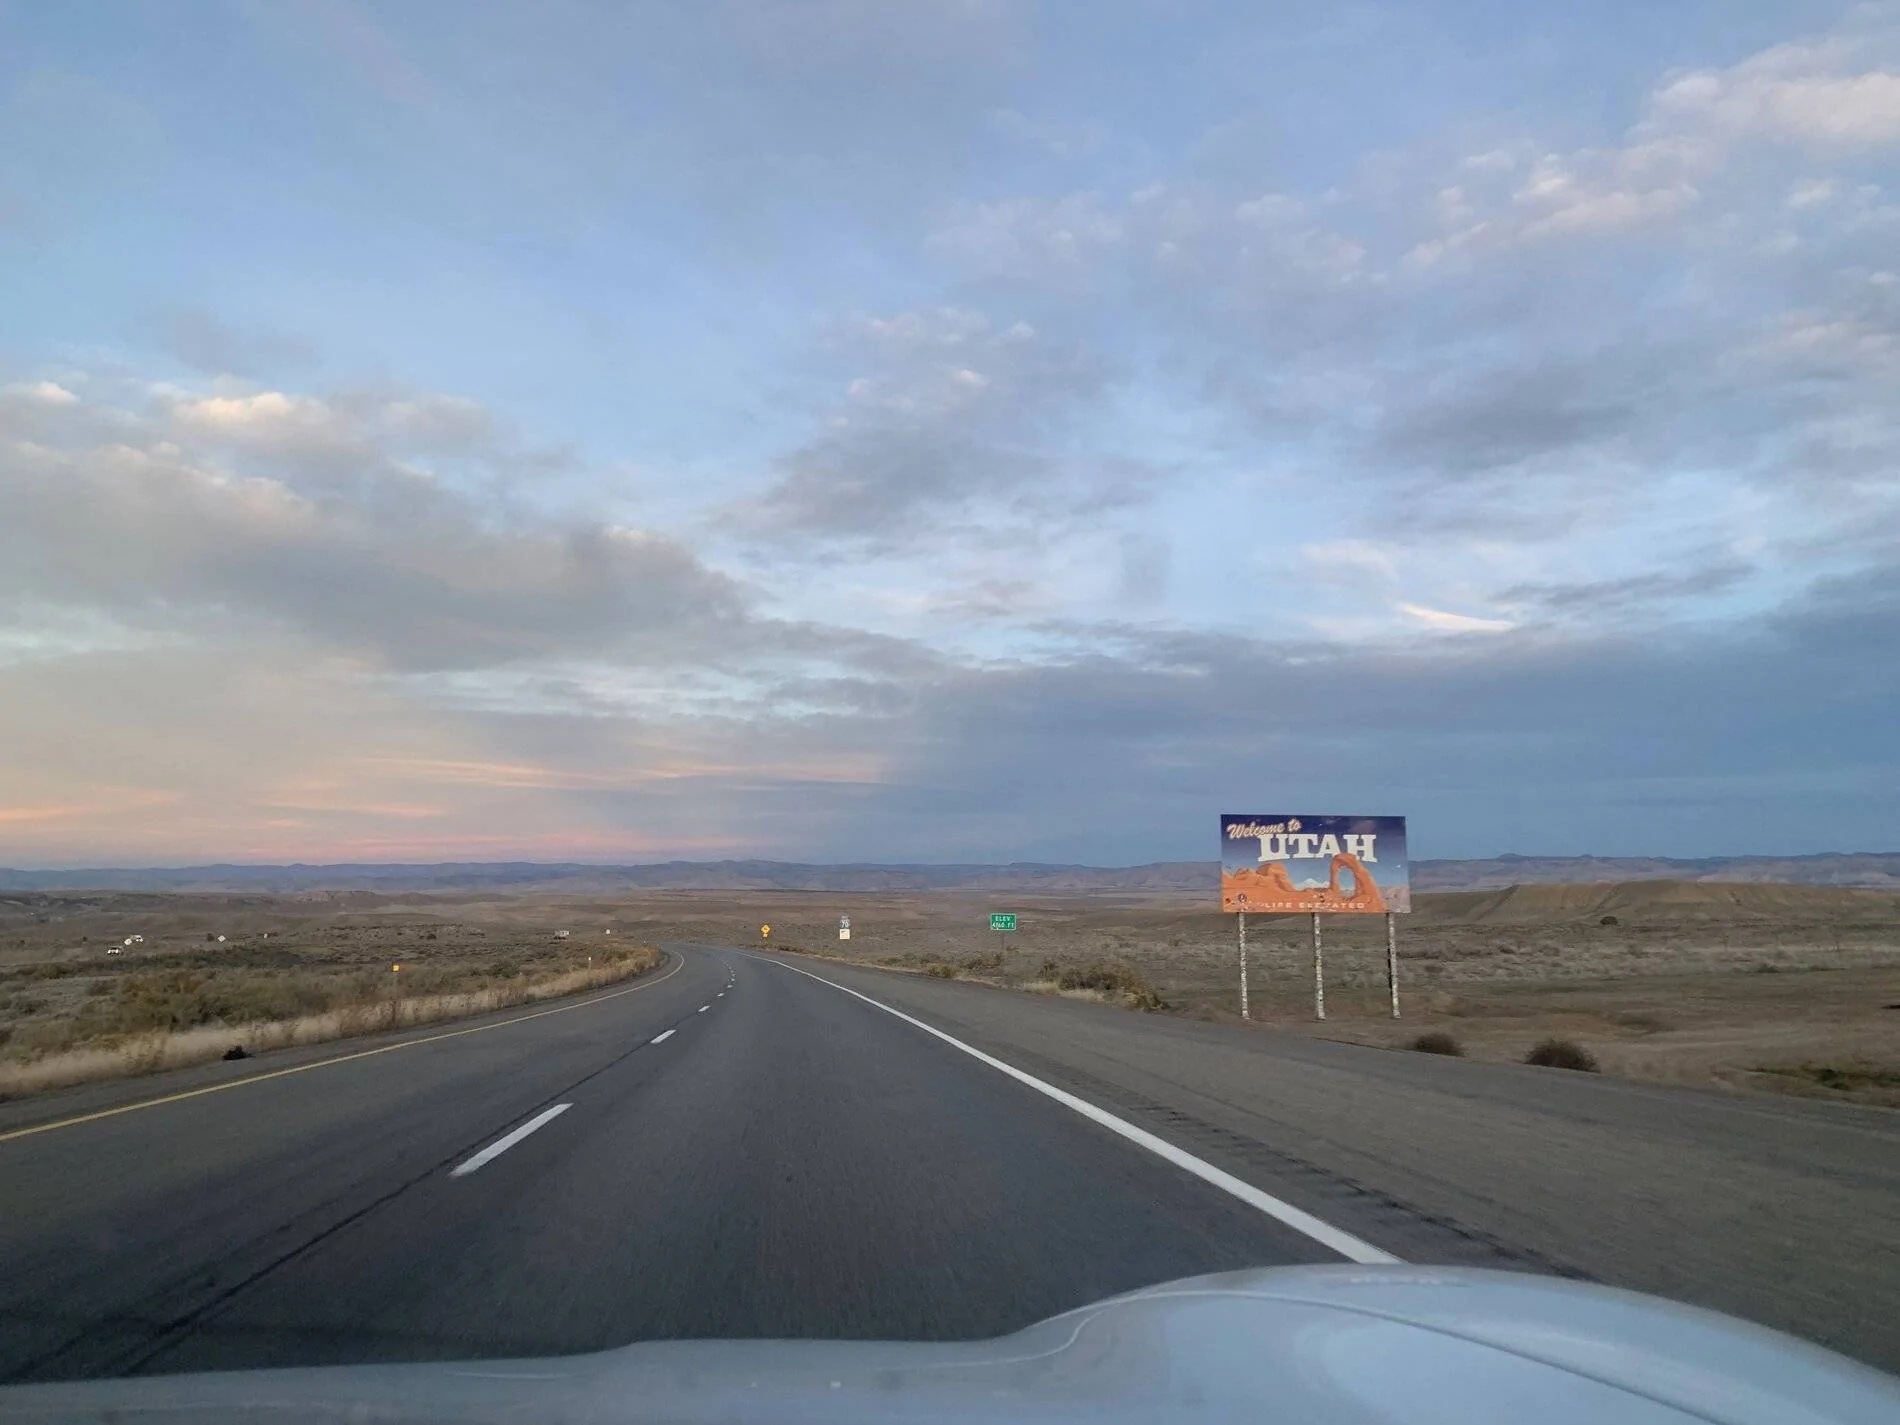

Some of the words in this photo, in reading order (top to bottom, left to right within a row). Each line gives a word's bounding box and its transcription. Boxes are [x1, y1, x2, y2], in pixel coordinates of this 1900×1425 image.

[1226, 821, 1284, 839] Welcome
[1287, 817, 1302, 833] to
[1257, 833, 1378, 863] UTAH
